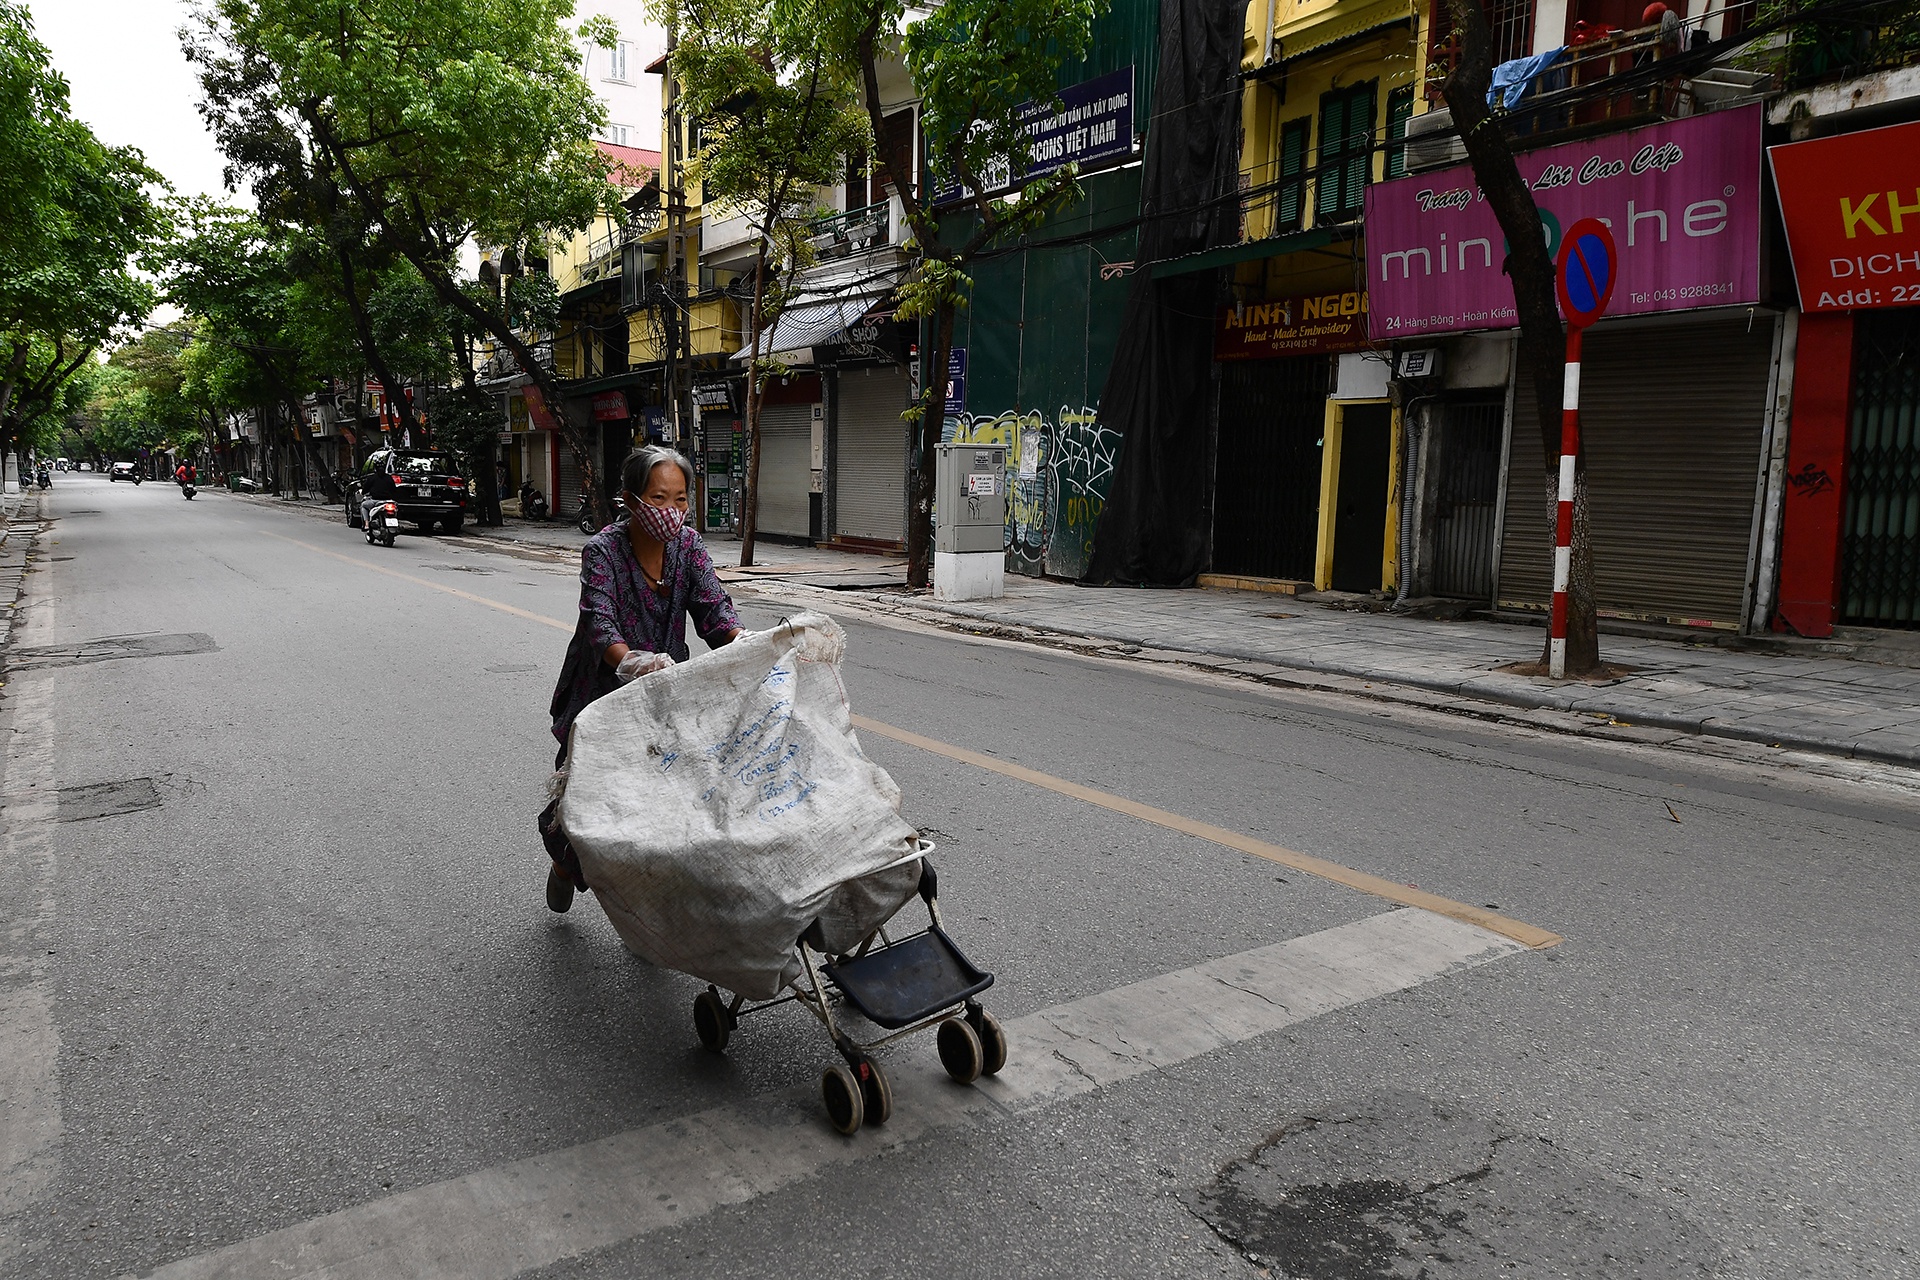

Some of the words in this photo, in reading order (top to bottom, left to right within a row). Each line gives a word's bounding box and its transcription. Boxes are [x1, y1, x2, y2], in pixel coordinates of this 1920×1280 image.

[1032, 121, 1040, 136] TY
[1068, 104, 1082, 125] VẤN
[1083, 102, 1092, 120] VÀ
[1092, 98, 1107, 117] XÂY
[1108, 92, 1128, 113] DỰNG
[1066, 125, 1088, 155] VIỆT
[1090, 119, 1116, 147] NAM
[1416, 189, 1472, 212] Trang
[1532, 164, 1574, 191] Lót
[1577, 156, 1625, 185] Cao
[1629, 142, 1684, 175] Cấp
[1381, 199, 1728, 282] minhe
[1829, 251, 1920, 280] DỊCH
[1630, 292, 1650, 304] Tel:
[1653, 288, 1677, 301] 043
[1680, 282, 1733, 299] 9288341
[1817, 288, 1881, 308] Add:
[1386, 316, 1402, 330] 24
[1404, 317, 1428, 329] Hàng
[1430, 315, 1454, 326] Bông
[1463, 310, 1488, 322] Hoàn
[1491, 306, 1516, 319] Kiếm
[852, 326, 879, 342] SHOP
[1244, 330, 1267, 343] Hand
[1273, 328, 1297, 340] Made
[1299, 322, 1352, 337] Embroidery
